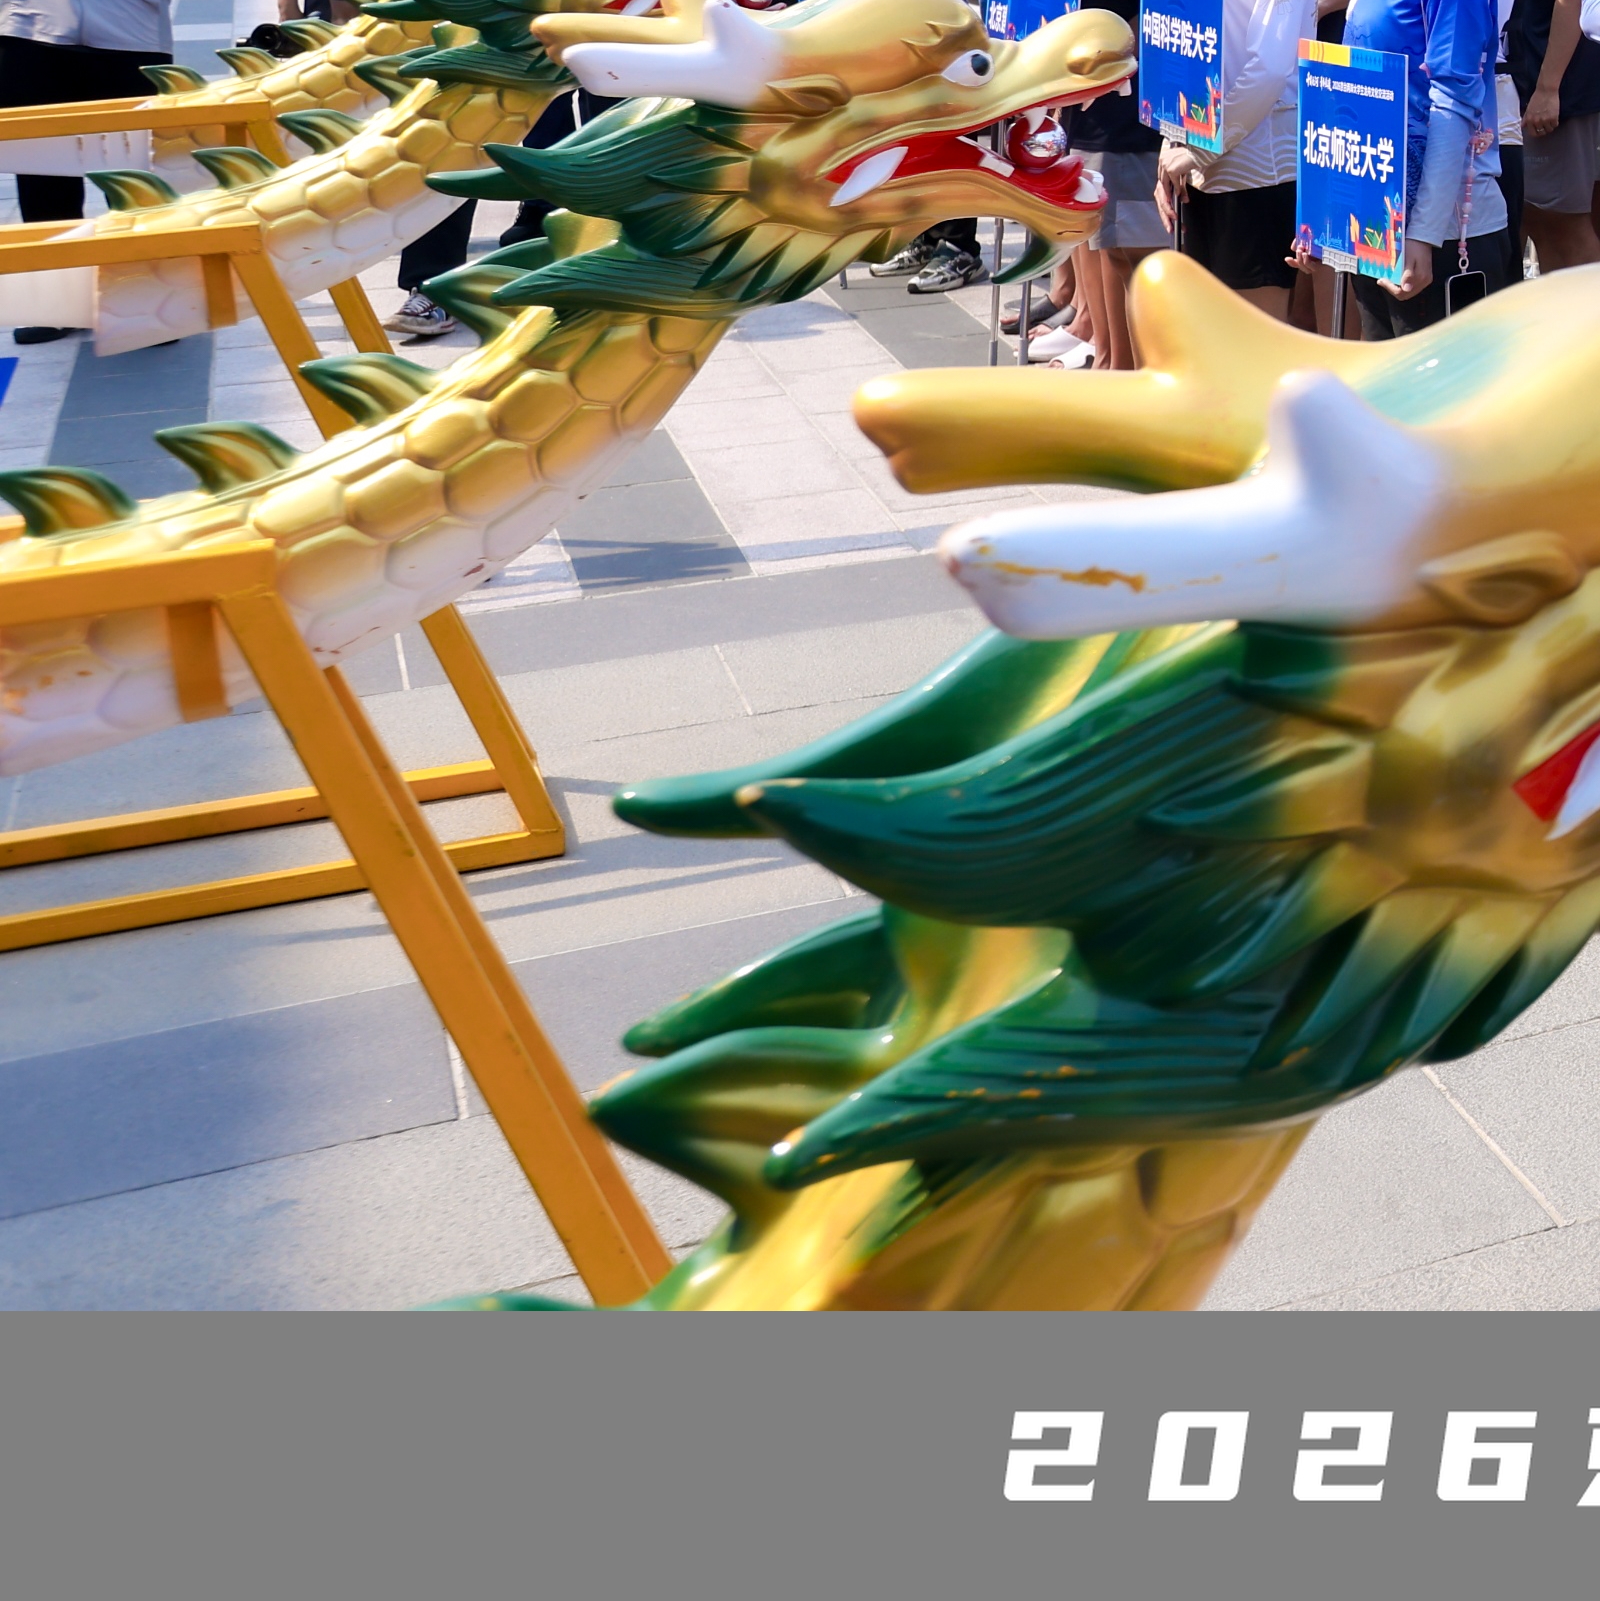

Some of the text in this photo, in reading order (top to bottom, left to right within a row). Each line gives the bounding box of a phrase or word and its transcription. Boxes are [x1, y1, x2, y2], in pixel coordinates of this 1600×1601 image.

[1142, 8, 1217, 64] 中国科学院大学
[1303, 120, 1394, 183] 北京师范大学
